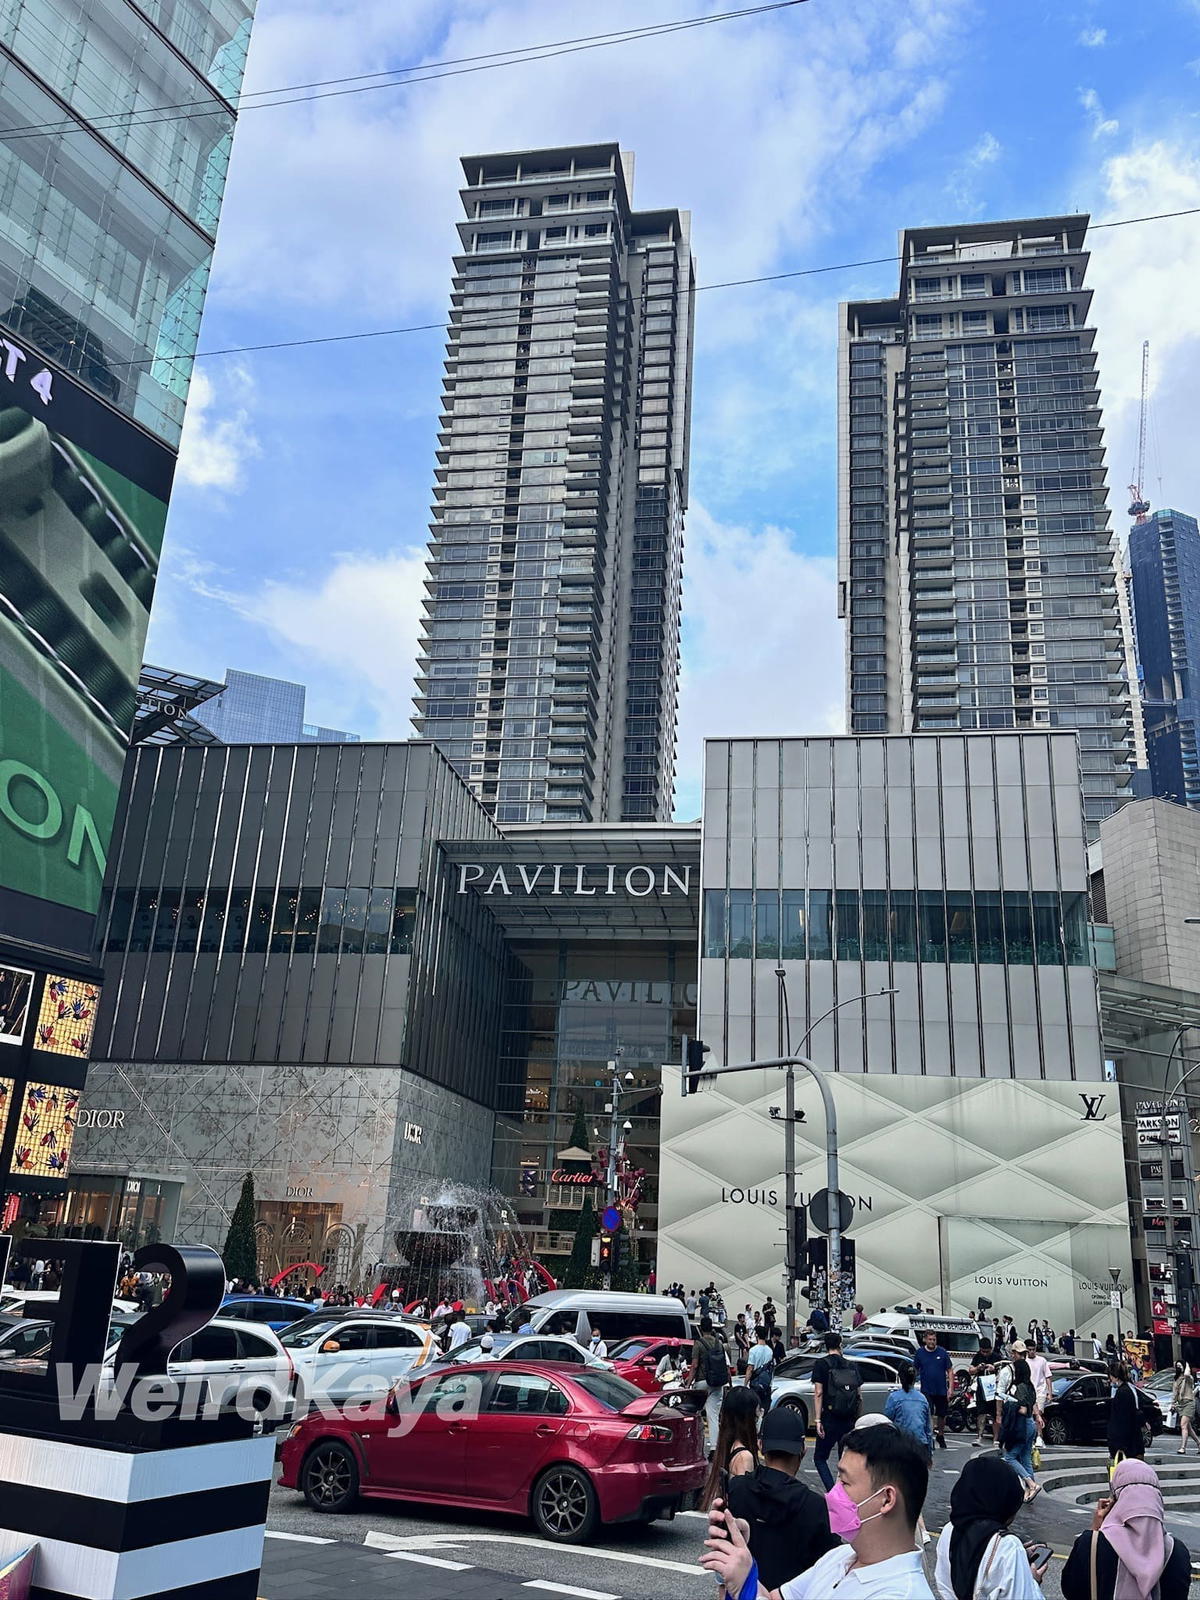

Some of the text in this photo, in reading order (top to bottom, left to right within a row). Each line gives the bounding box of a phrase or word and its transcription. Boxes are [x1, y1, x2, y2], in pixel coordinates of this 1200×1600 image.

[456, 864, 692, 897] PAVILION
[1136, 1099, 1179, 1110] PAVILON
[77, 1109, 125, 1129] DIOR
[551, 1168, 593, 1183] Cartier
[286, 1186, 313, 1197] DIOR
[721, 1188, 778, 1206] LOUIS
[975, 1276, 1048, 1288] LOUIS VUITTON
[1078, 1282, 1129, 1292] LOUIS VUITON
